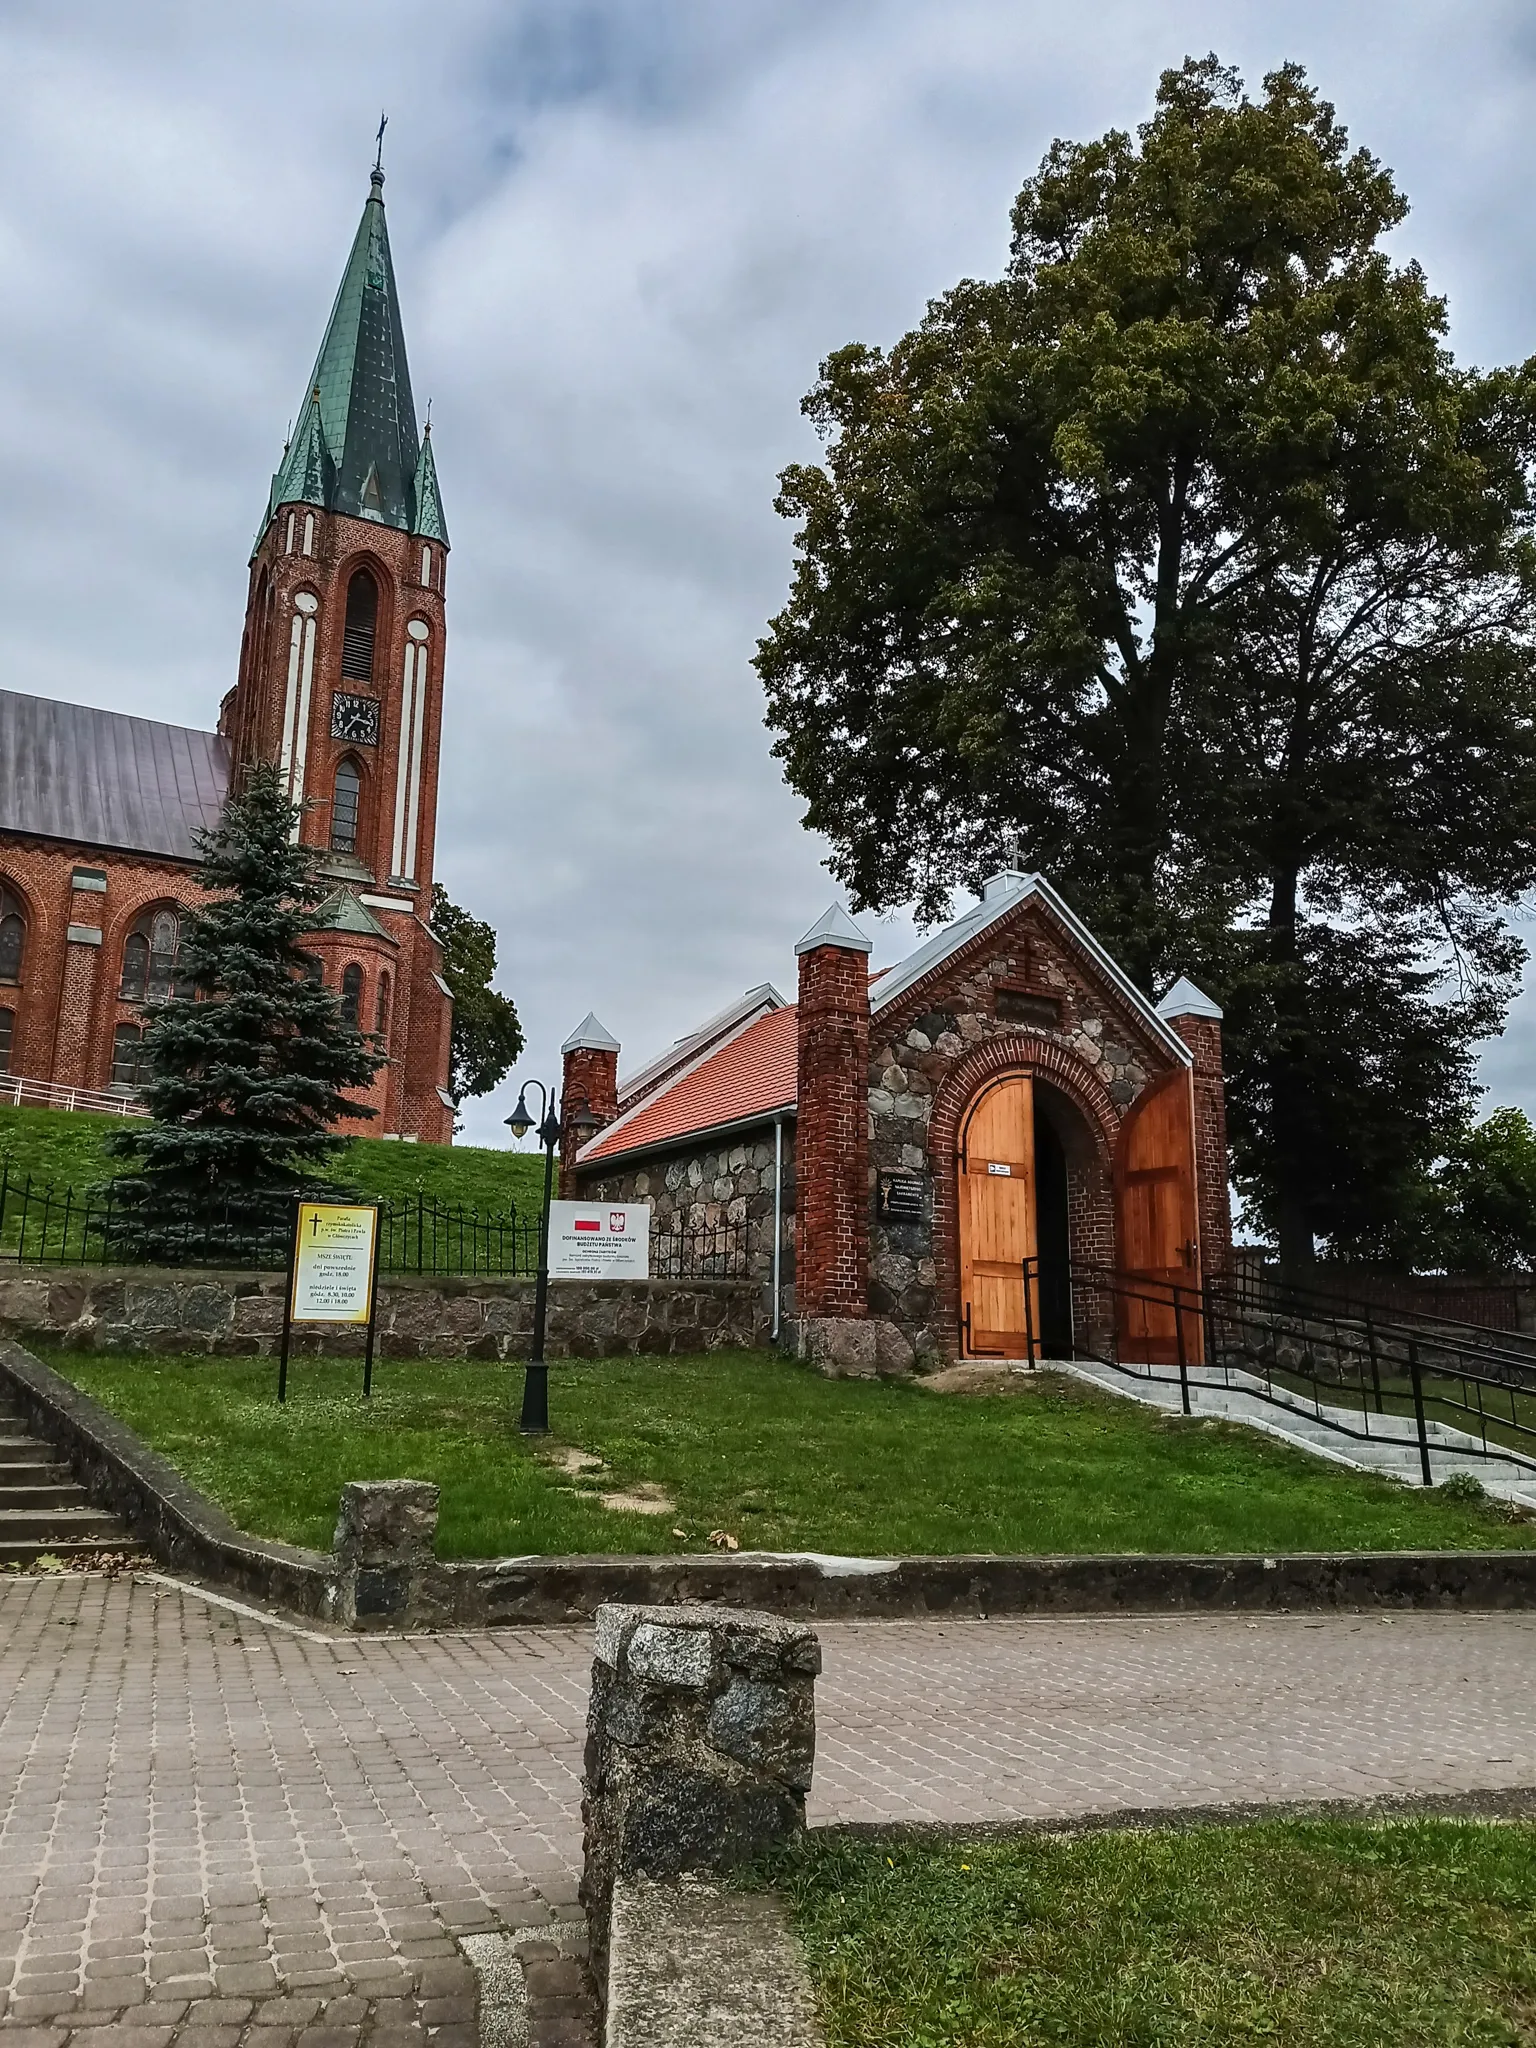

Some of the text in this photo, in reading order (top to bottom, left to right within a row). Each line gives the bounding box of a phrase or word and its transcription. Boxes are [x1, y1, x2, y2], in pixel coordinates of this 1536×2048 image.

[353, 700, 359, 708] 12
[336, 712, 342, 720] 9
[339, 720, 344, 728] 8
